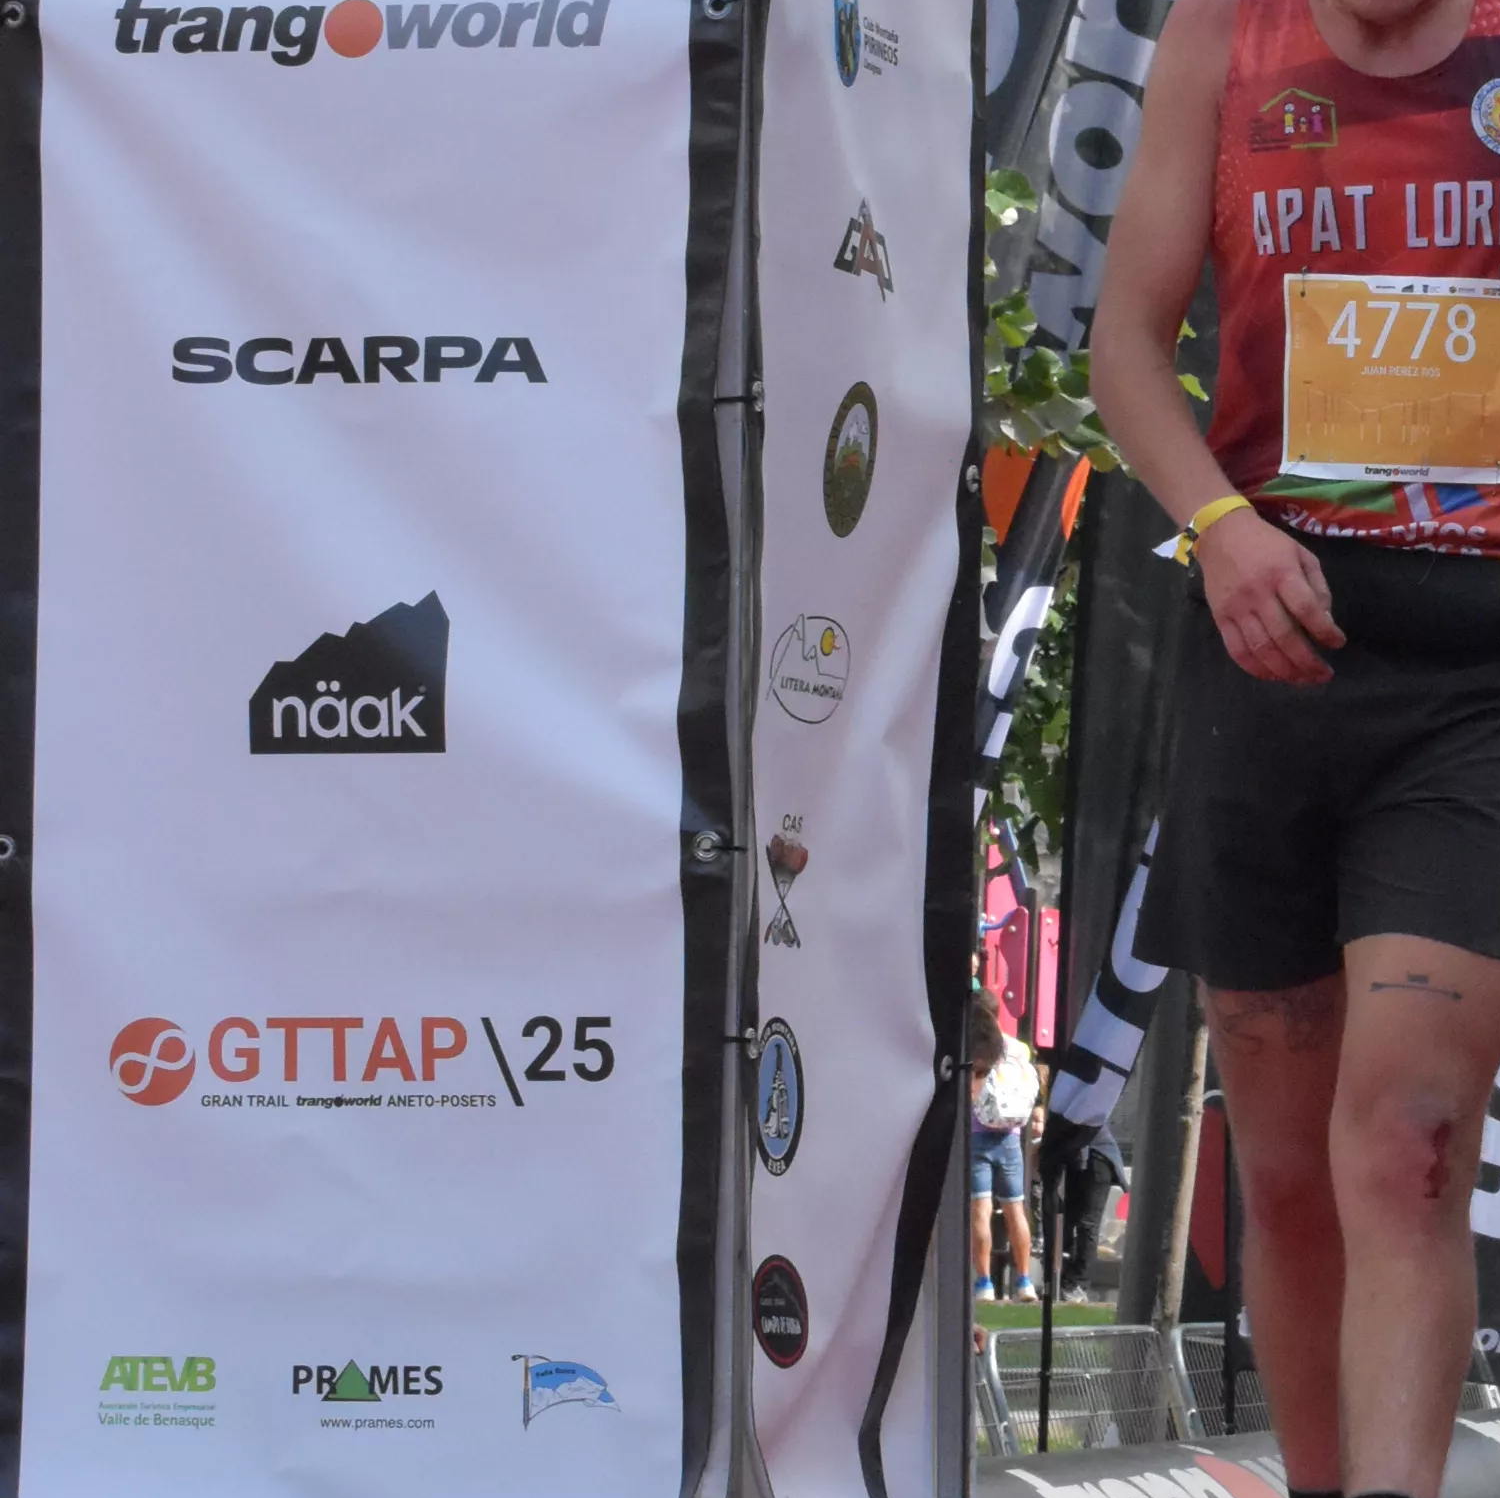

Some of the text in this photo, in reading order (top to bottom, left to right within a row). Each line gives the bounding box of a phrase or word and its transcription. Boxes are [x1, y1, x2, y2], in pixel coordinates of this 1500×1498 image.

[1251, 184, 1376, 256] APAT
[1327, 300, 1477, 363] 4778
[172, 335, 549, 386] SCARPA
[1360, 364, 1387, 376] JUAN
[272, 680, 428, 740] näak
[207, 1016, 468, 1082] GTTAP
[201, 1094, 243, 1107] GRAN
[246, 1094, 289, 1107] TRAIL
[386, 1094, 497, 1108] ANETO-POSETS
[98, 1355, 217, 1393] ATEVB
[98, 1412, 216, 1430] Valle de Benasque
[319, 1416, 436, 1431] www.prames.com
